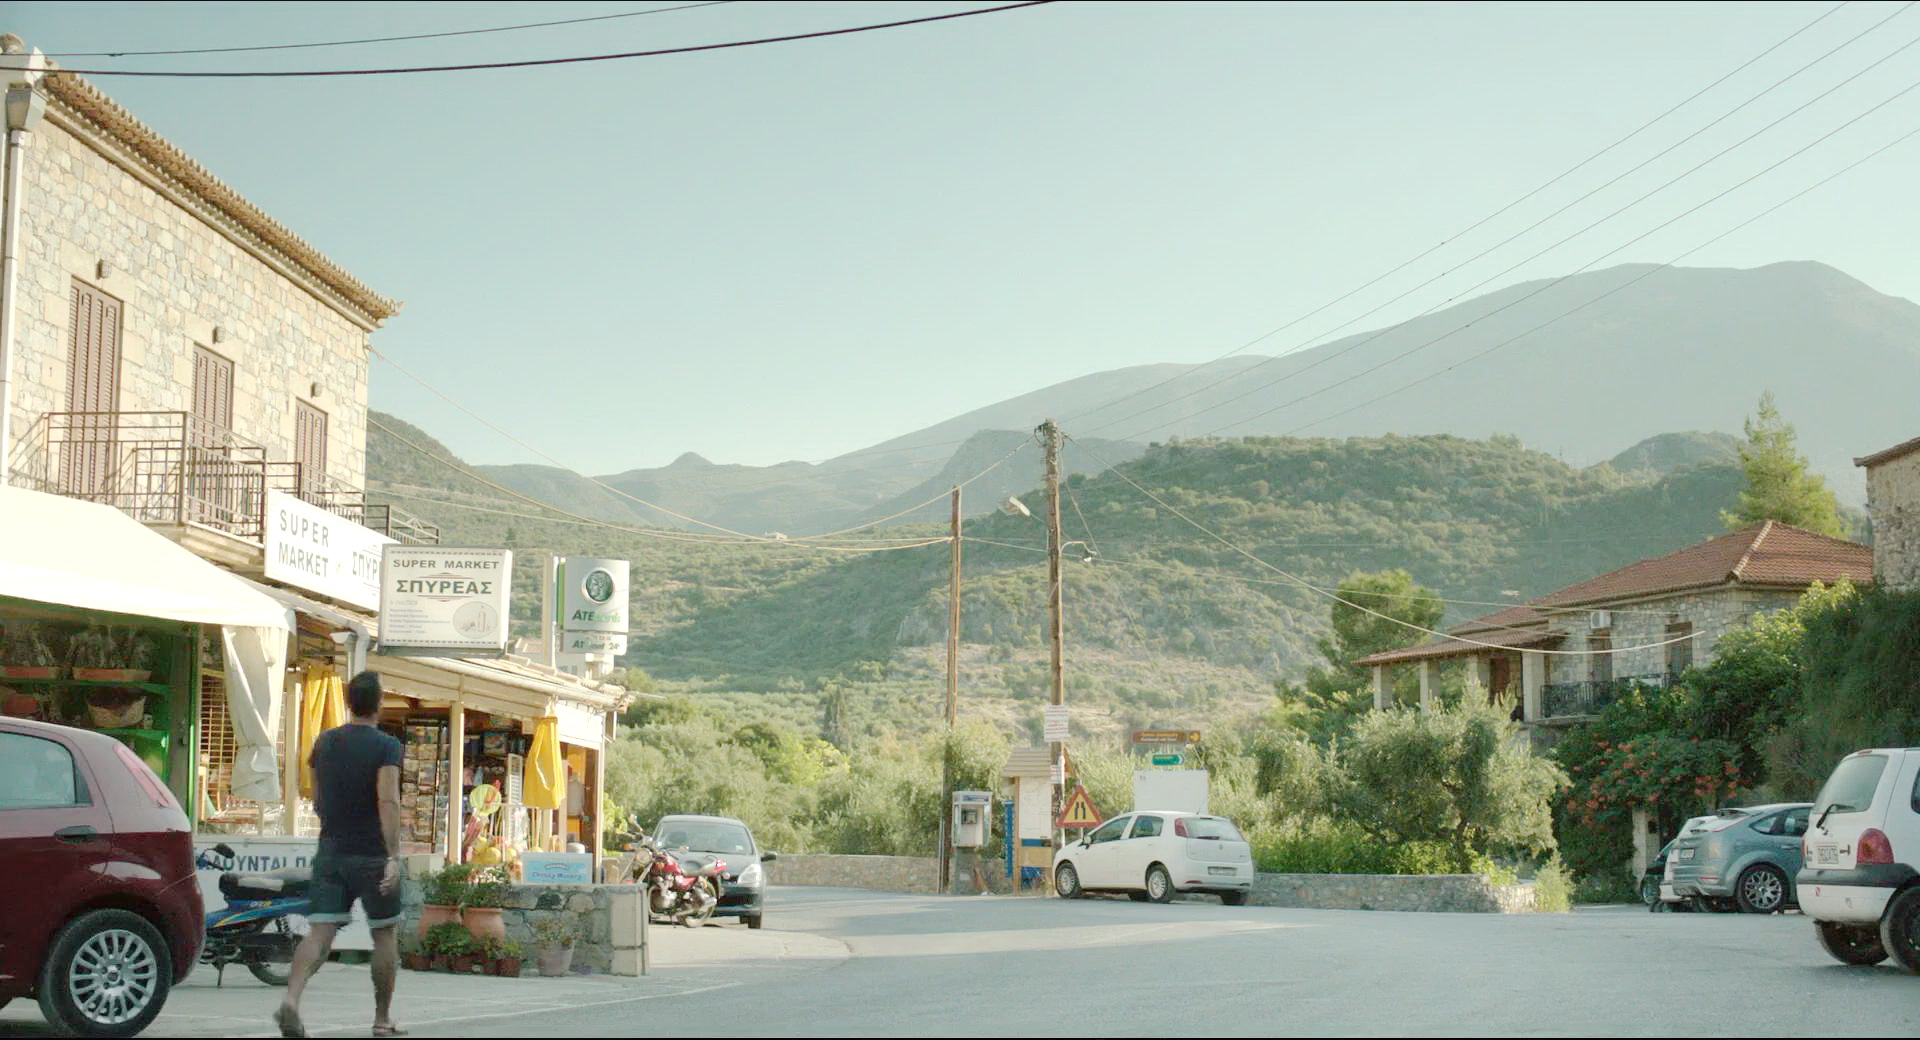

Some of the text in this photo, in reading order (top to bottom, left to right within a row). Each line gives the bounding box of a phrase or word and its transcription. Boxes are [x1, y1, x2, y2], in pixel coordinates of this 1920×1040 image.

[280, 509, 329, 547] SUPER
[279, 541, 329, 577] MARKET
[352, 551, 382, 581] ΣΠΥΡ
[393, 559, 499, 569] SUPER MARKET
[396, 580, 492, 594] ΣΠΥΡΕΑΣ
